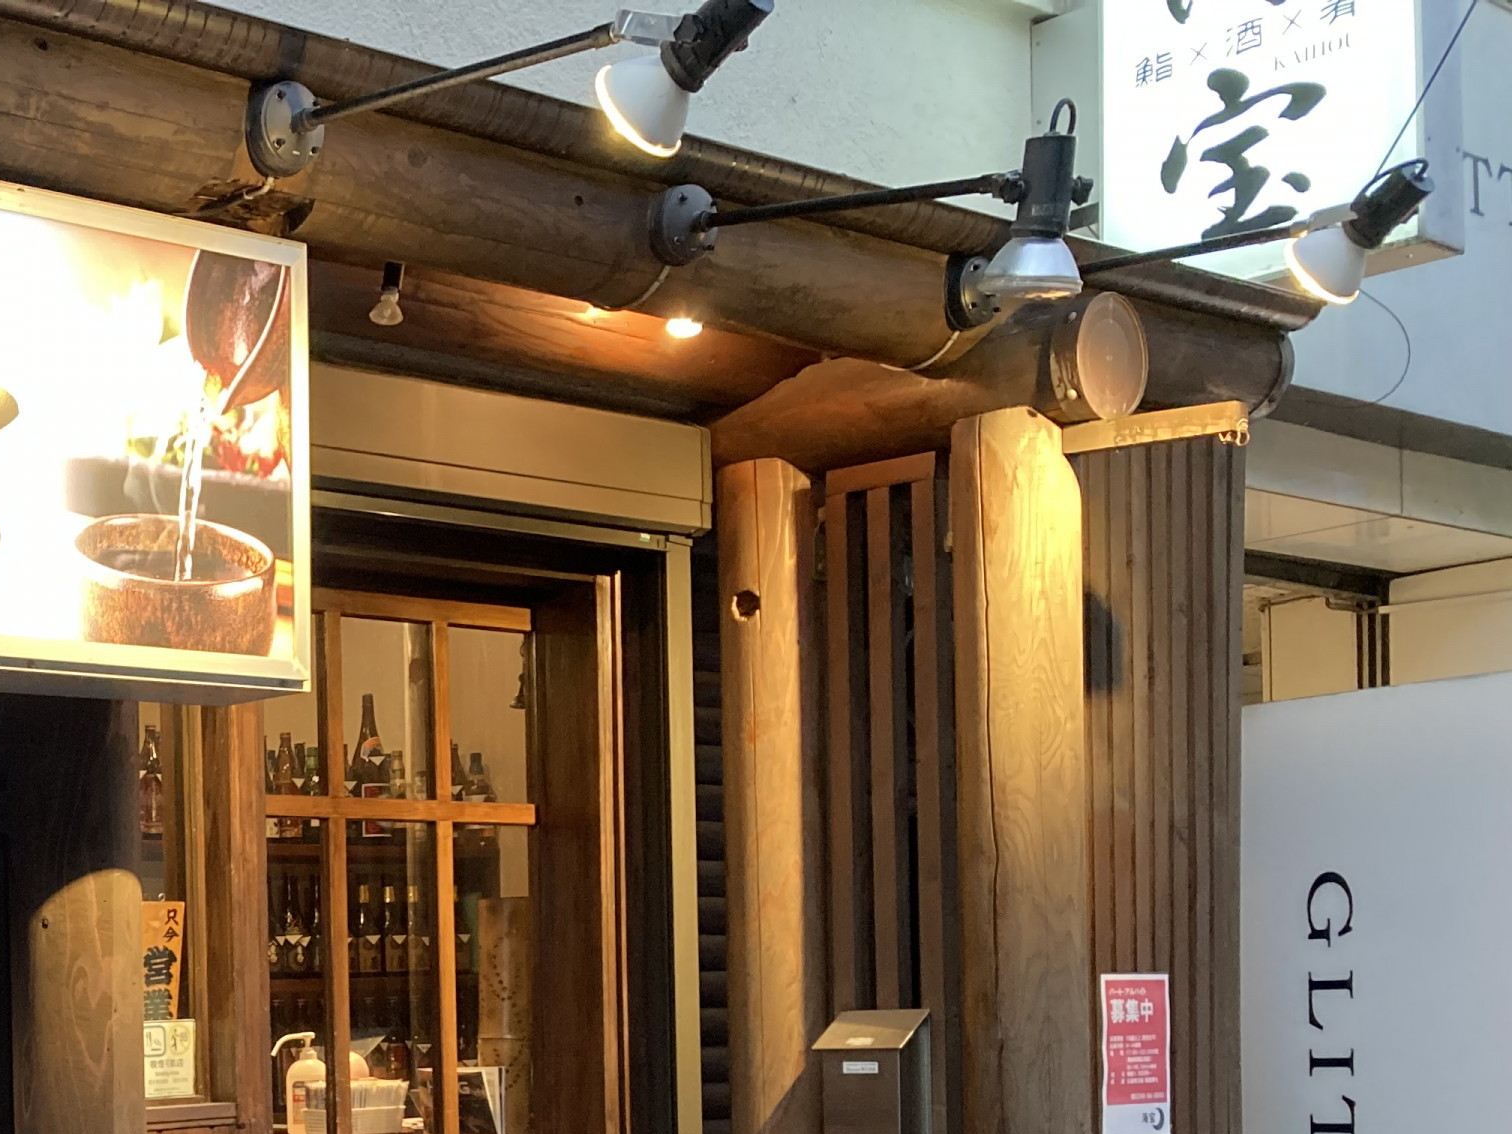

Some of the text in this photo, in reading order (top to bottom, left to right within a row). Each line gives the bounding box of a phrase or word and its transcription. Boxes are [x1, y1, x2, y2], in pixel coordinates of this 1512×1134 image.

[1462, 150, 1512, 226] T
[162, 908, 180, 942] 只今
[1109, 998, 1154, 1024] 募集中
